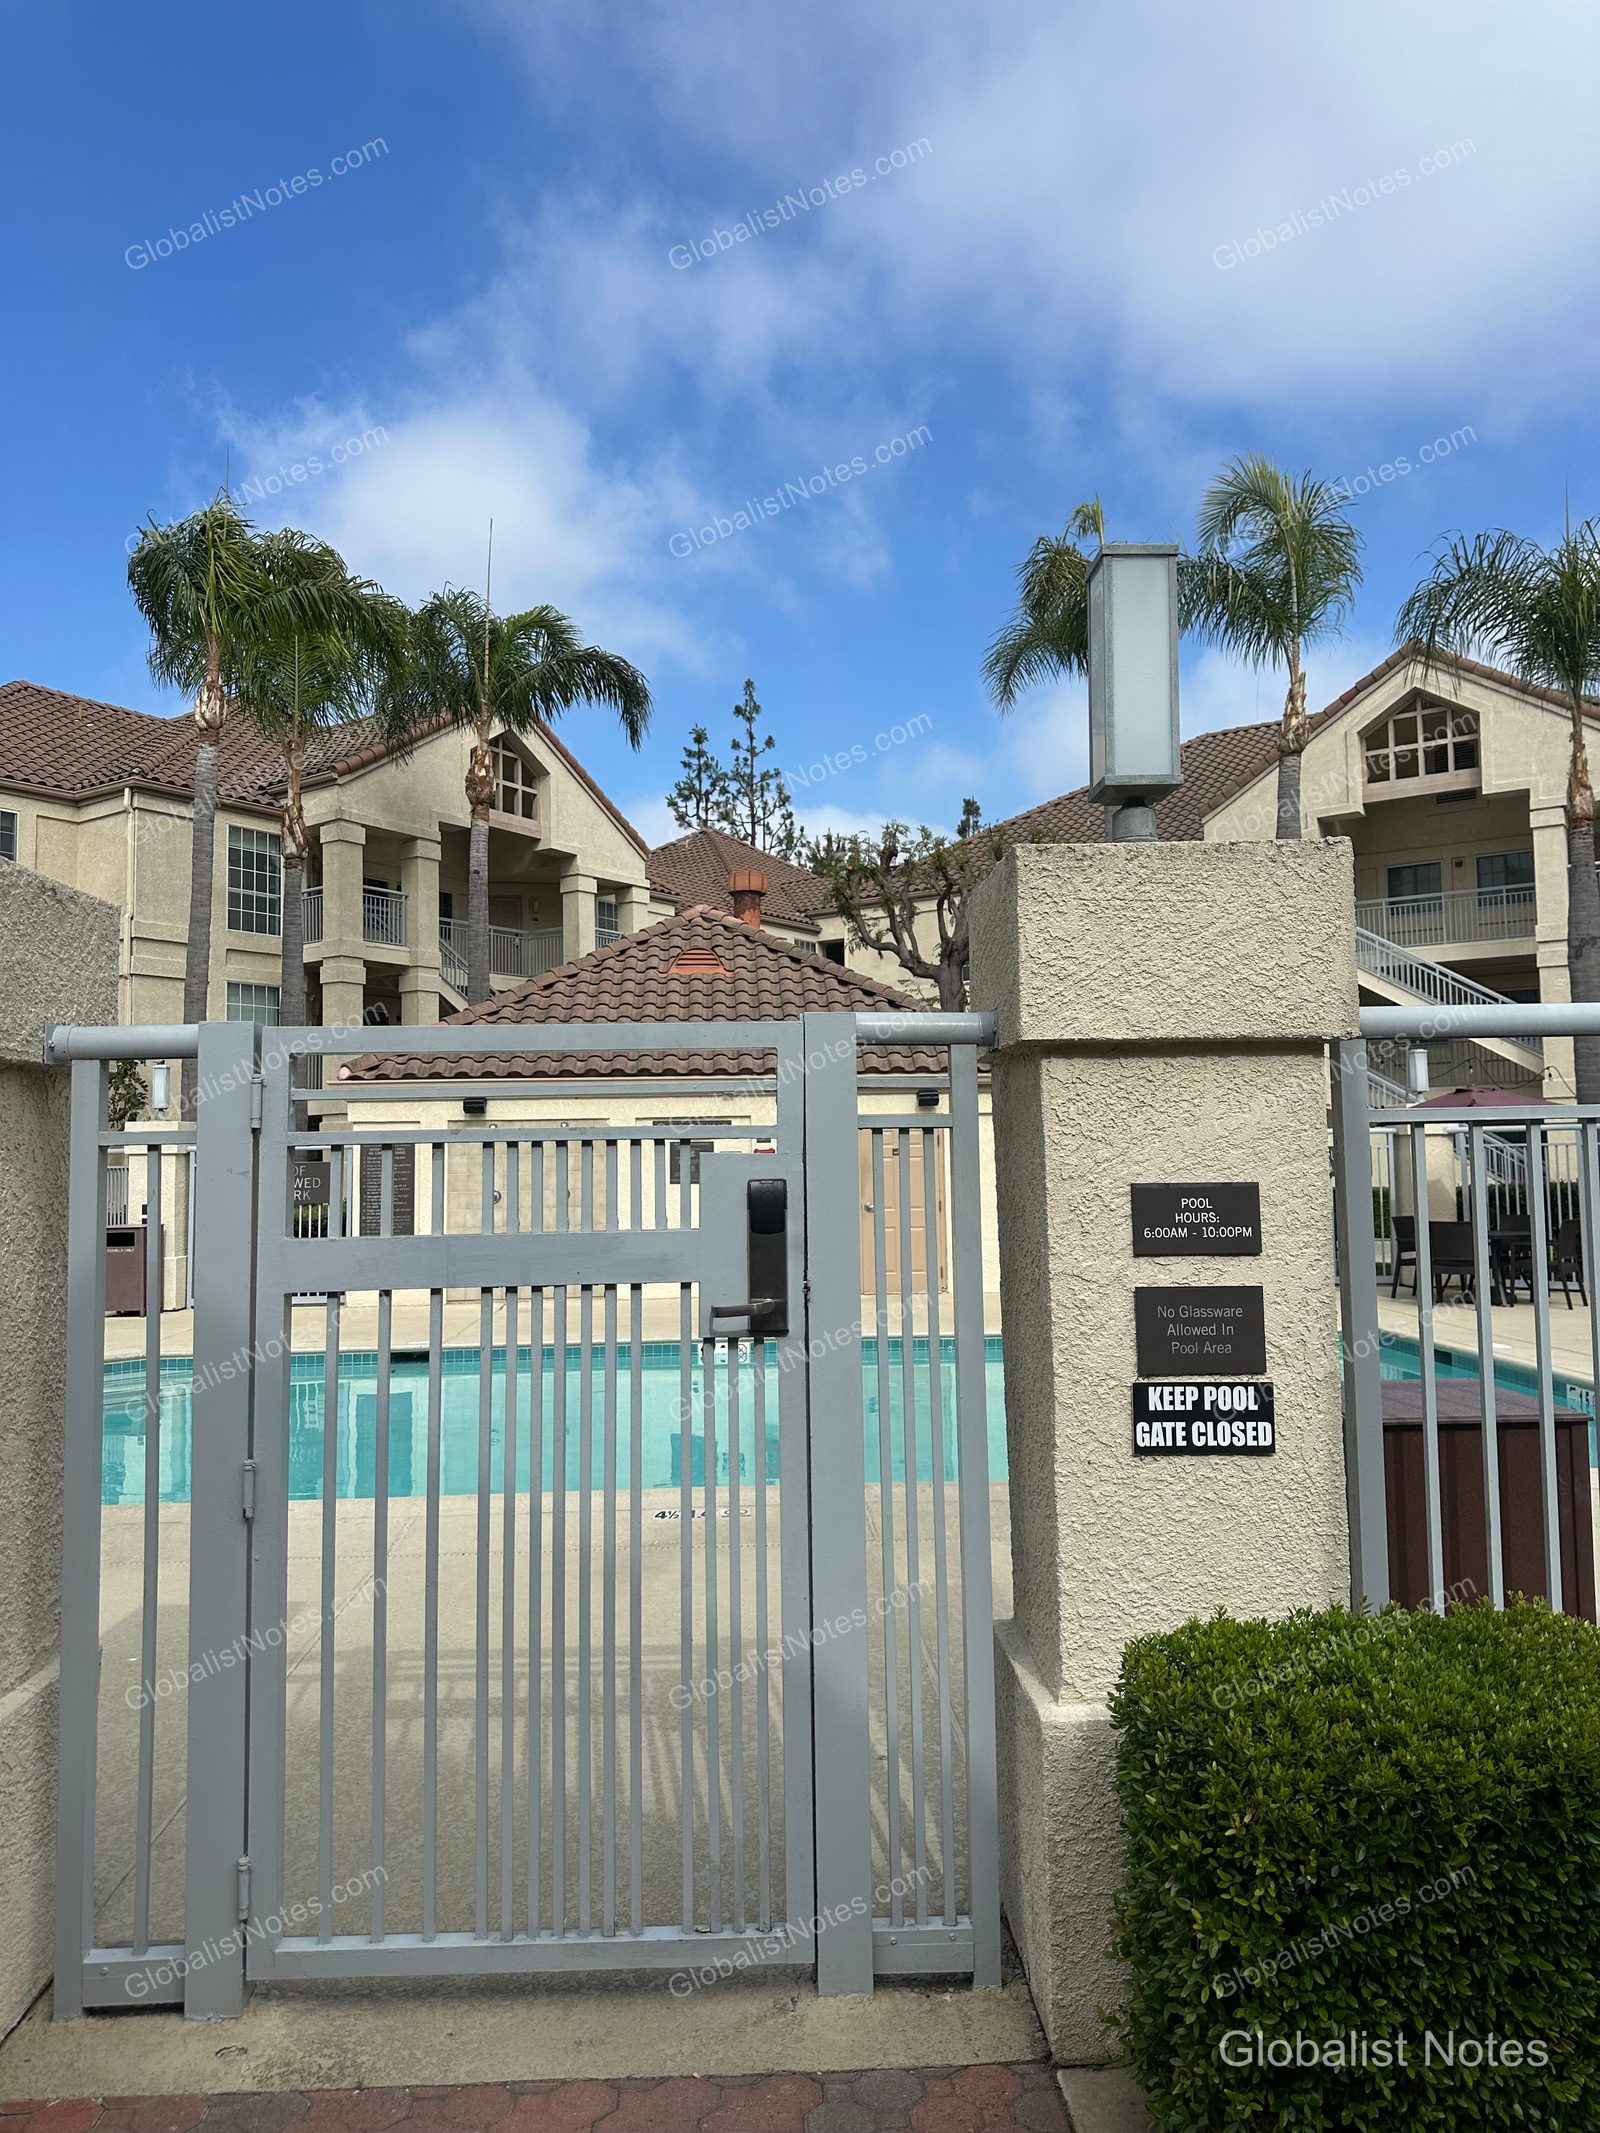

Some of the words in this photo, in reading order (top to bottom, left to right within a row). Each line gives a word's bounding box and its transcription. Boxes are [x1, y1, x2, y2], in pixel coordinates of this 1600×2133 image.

[1181, 1198, 1213, 1209] POOL
[1175, 1212, 1220, 1223] HOURS:
[1143, 1227, 1188, 1238] 6:00AM
[1202, 1227, 1253, 1238] 10:00PM
[1157, 1305, 1175, 1318] No
[1179, 1305, 1243, 1318] Glassware
[1167, 1323, 1216, 1336] Allowed
[1222, 1323, 1234, 1335] In
[1171, 1341, 1199, 1354] Pool
[1203, 1341, 1232, 1354] Area
[1148, 1386, 1199, 1411] KEEP
[1203, 1385, 1259, 1411] POOL
[1135, 1421, 1187, 1447] GATE
[1191, 1420, 1273, 1447] CLOSED
